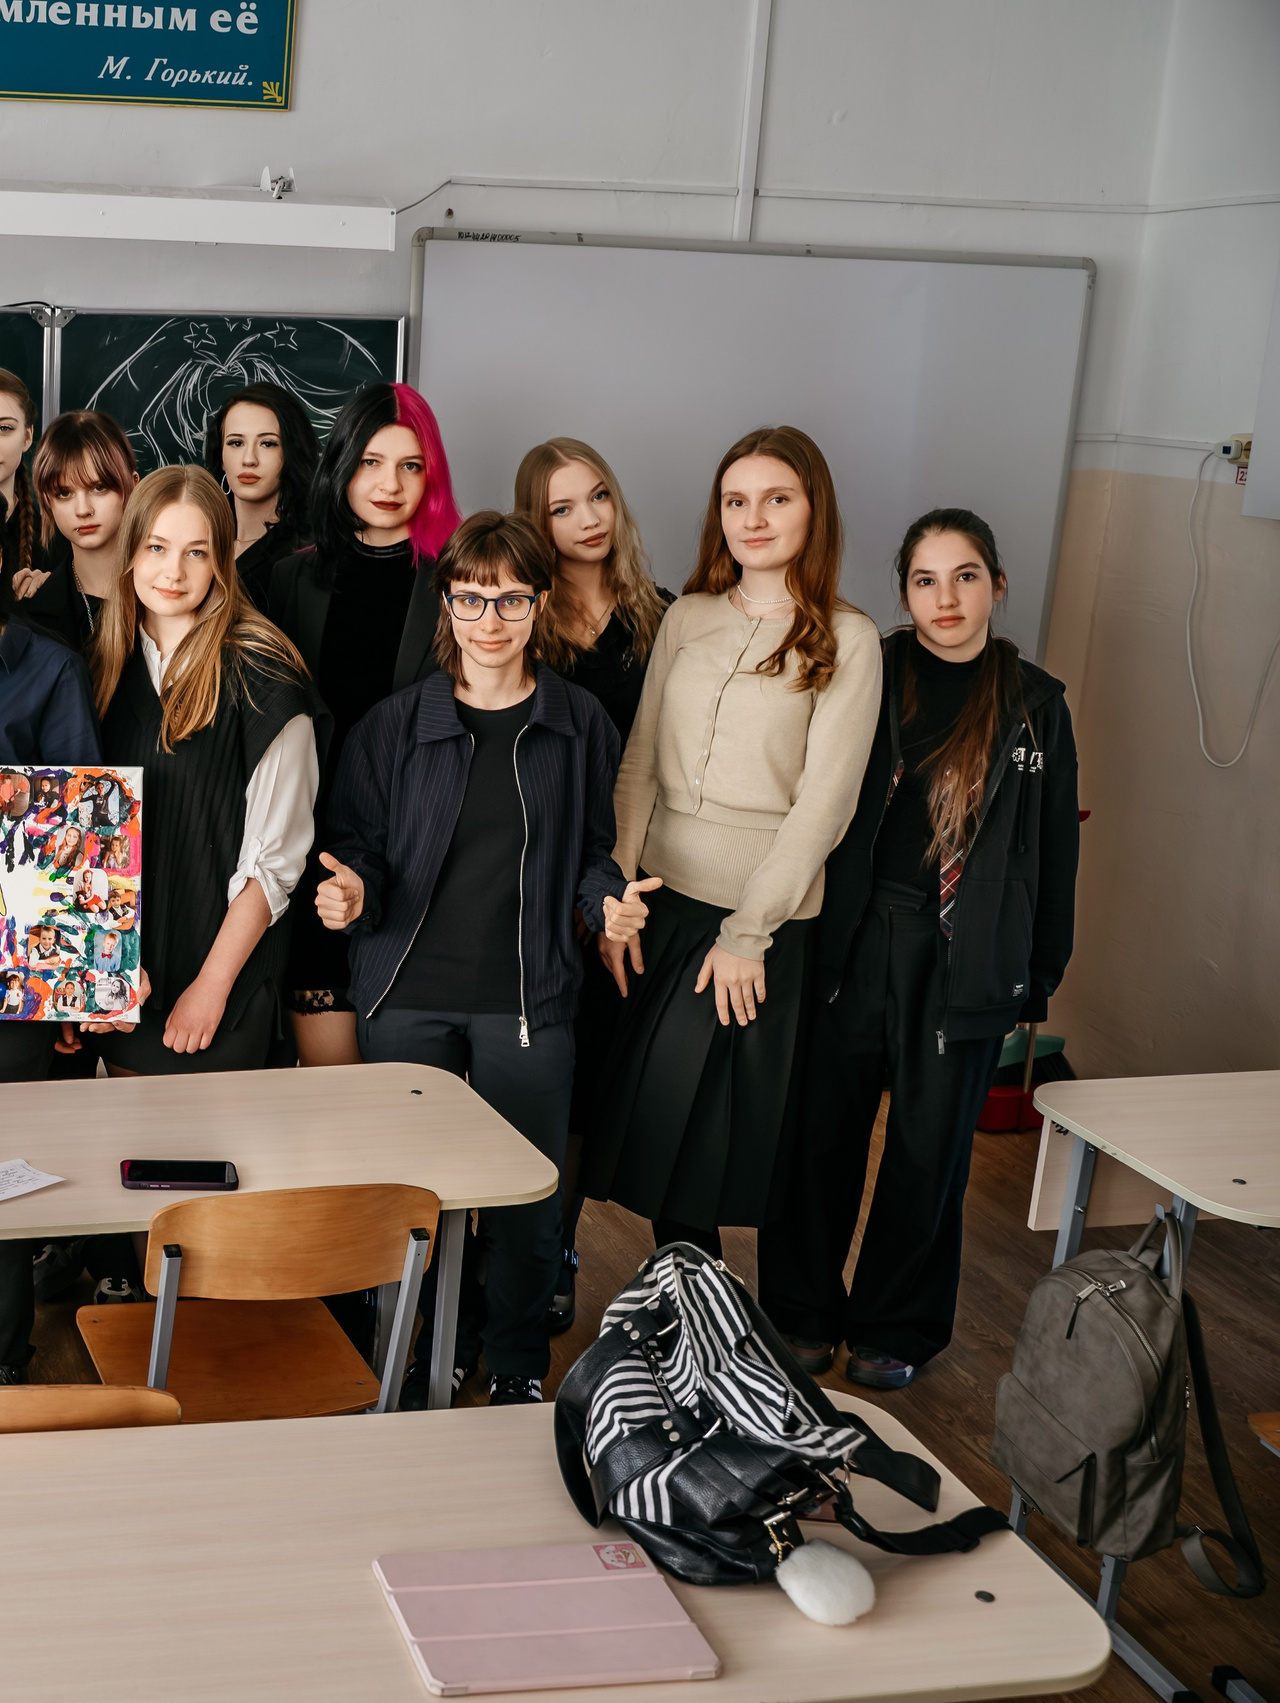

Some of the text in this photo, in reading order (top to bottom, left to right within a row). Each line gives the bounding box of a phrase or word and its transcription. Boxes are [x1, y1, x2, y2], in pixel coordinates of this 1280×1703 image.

[209, 2, 259, 35] её
[97, 55, 254, 88] М. Горький.
